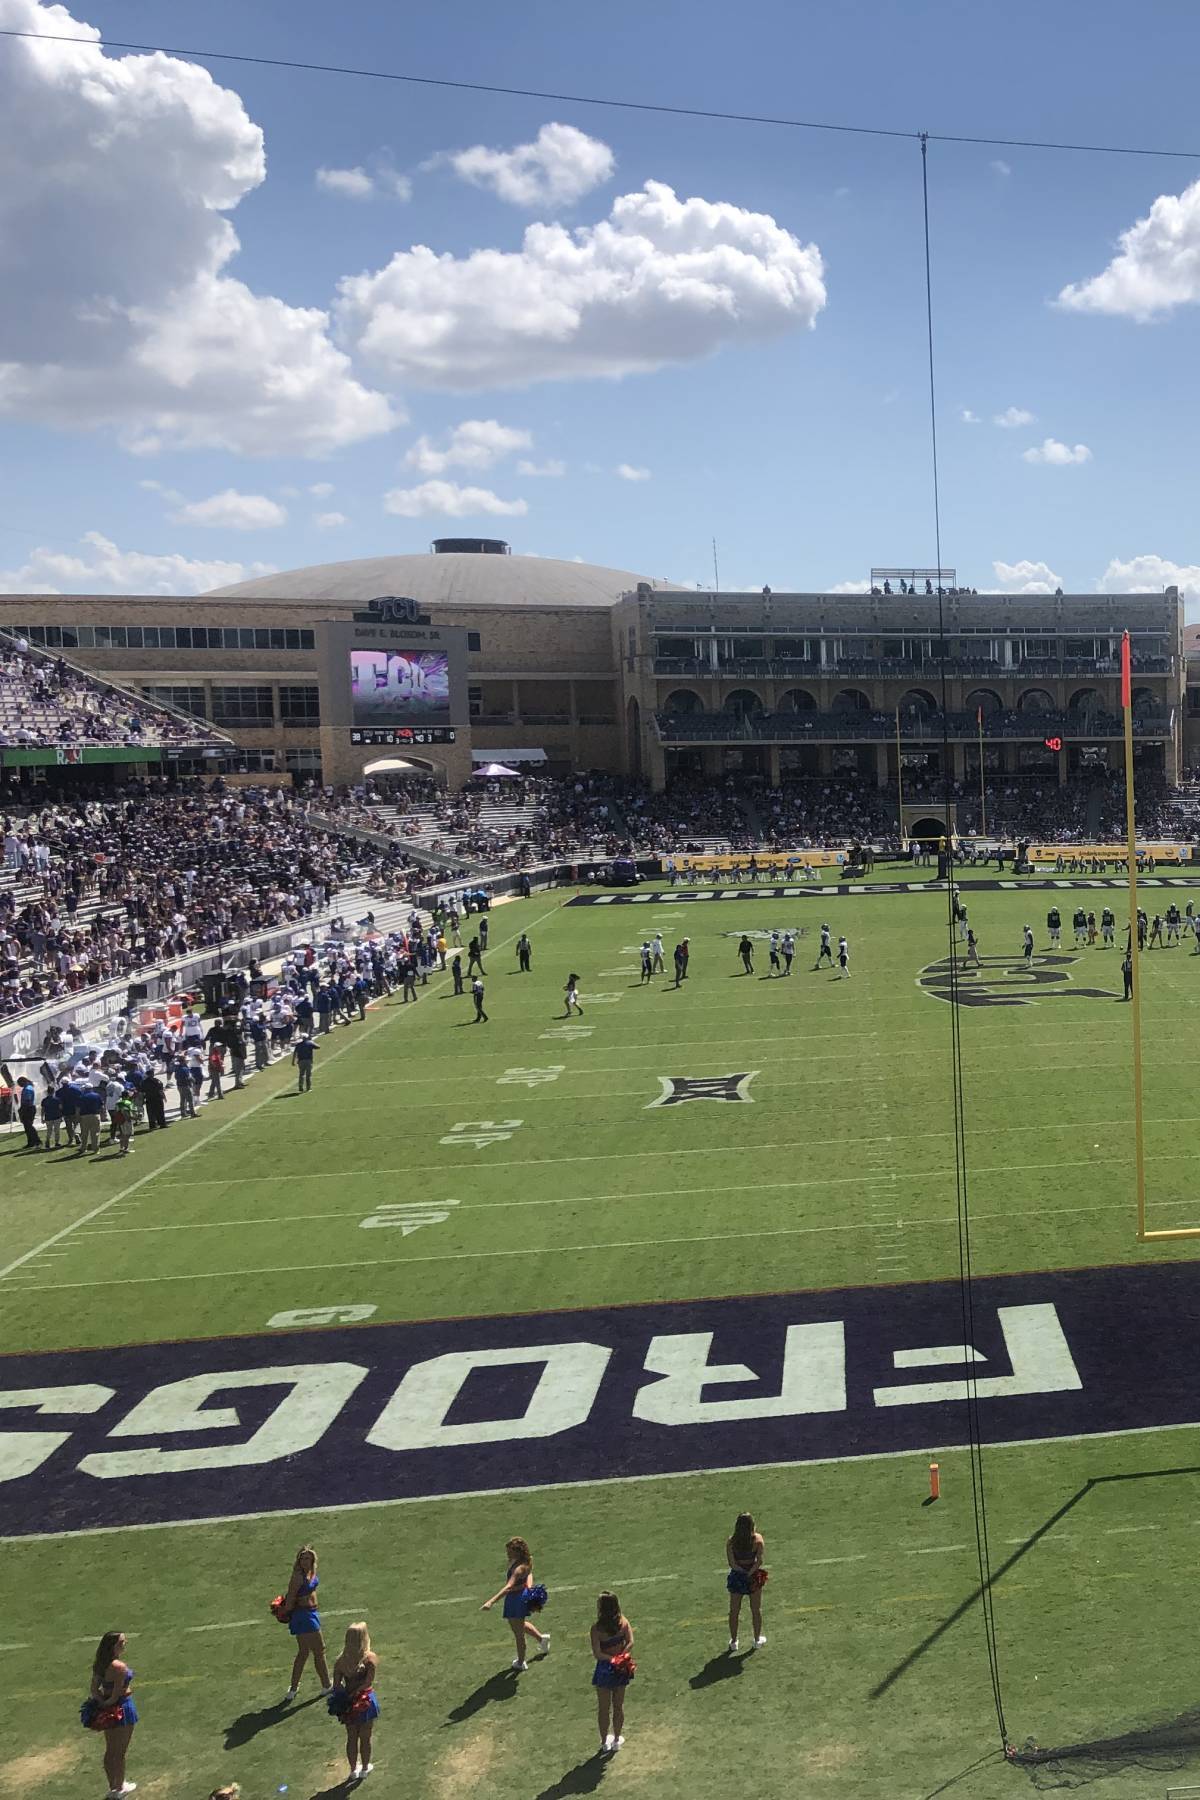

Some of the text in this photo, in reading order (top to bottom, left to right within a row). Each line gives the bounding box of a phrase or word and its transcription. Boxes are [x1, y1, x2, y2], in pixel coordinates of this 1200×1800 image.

[381, 598, 418, 621] TCU
[1045, 738, 1061, 750] 40
[592, 882, 961, 904] HORNED
[75, 1000, 105, 1028] HORNED
[496, 1065, 566, 1084] 30
[439, 1119, 525, 1145] 20
[358, 1199, 461, 1229] 10
[265, 1303, 379, 1328] G
